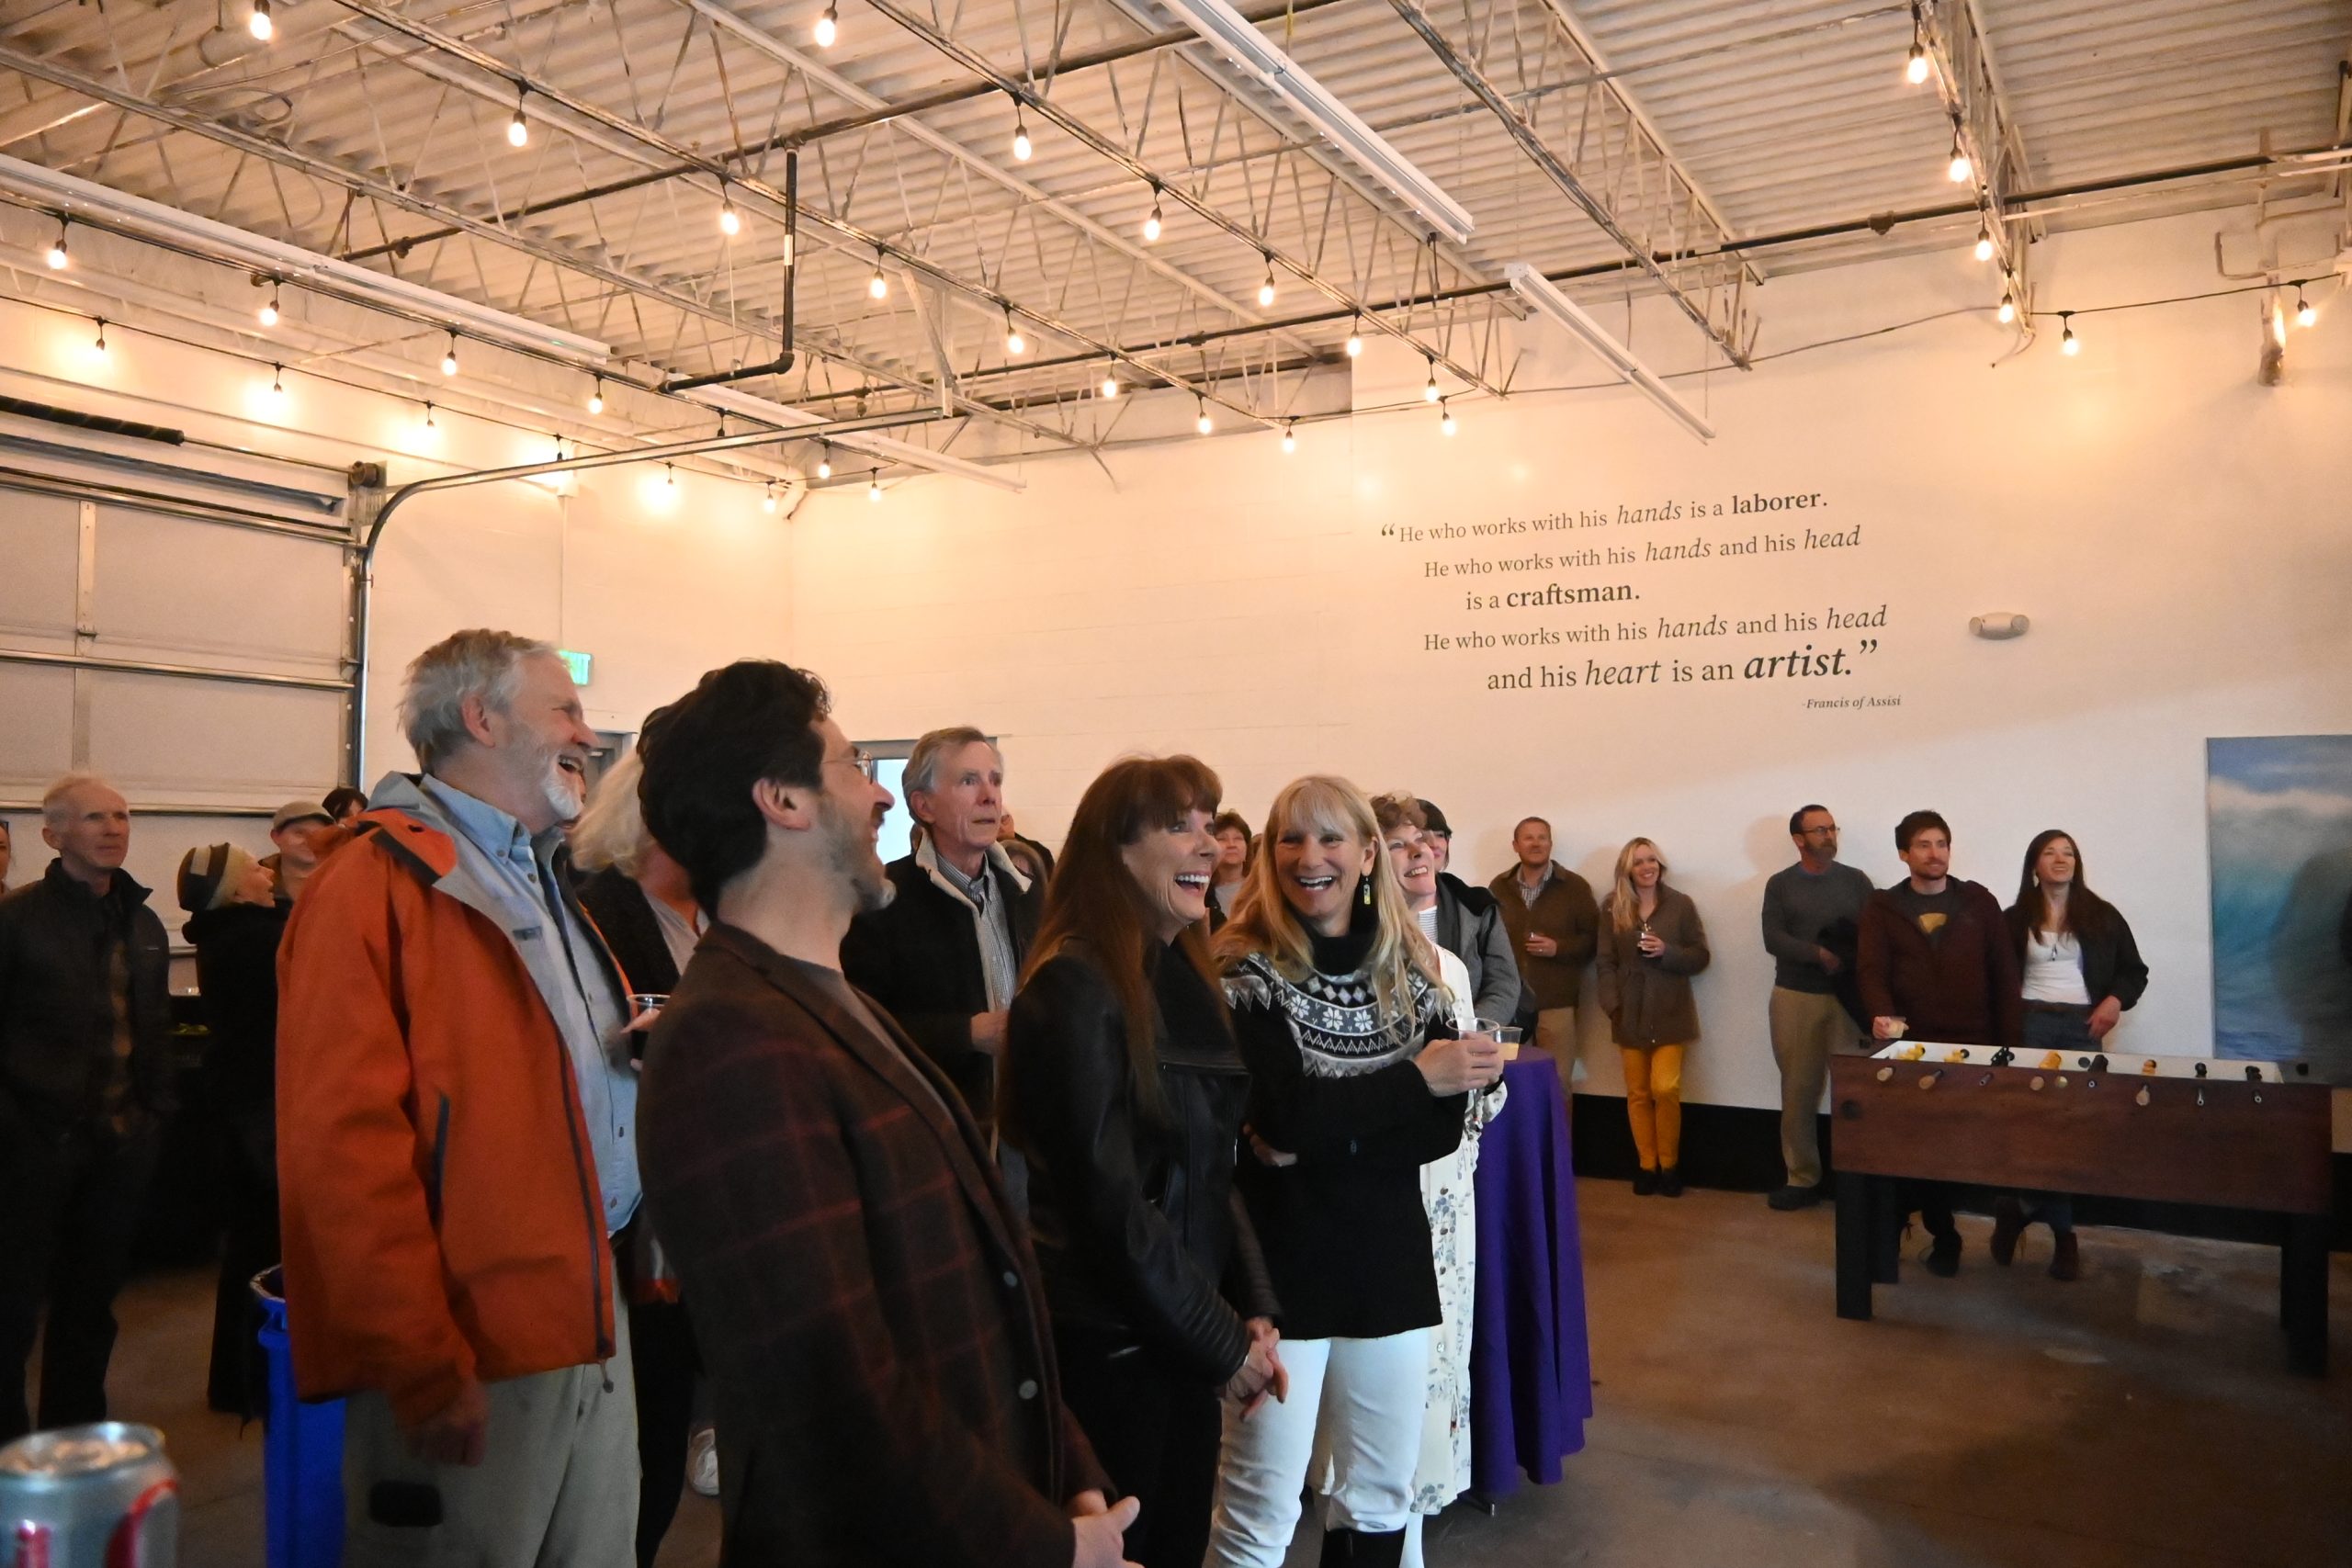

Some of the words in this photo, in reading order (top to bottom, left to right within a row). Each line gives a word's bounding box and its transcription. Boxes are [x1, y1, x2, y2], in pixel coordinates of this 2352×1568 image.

[1429, 523, 1466, 539] who
[1472, 517, 1526, 536] works
[1532, 513, 1573, 531] with
[1580, 510, 1607, 527] his
[1618, 500, 1681, 525] hands
[1690, 502, 1706, 518] is
[1713, 504, 1724, 516] a
[1732, 493, 1827, 514] laborer.
[1425, 562, 1449, 577] He
[1453, 558, 1492, 574] who
[1498, 553, 1553, 571] works
[1559, 548, 1600, 567] with
[1608, 547, 1635, 564] his
[1646, 537, 1712, 561] hands
[1720, 536, 1757, 556] and
[1765, 534, 1795, 552] his
[1804, 525, 1860, 549] head
[1466, 592, 1482, 610] is
[1489, 595, 1499, 608] a
[1507, 583, 1640, 607] craftsman.
[1424, 634, 1450, 650] He
[1455, 631, 1496, 649] who
[1501, 627, 1560, 646] works
[1566, 624, 1610, 643] with
[1617, 622, 1647, 640] his
[1658, 615, 1727, 638] hands
[1736, 614, 1777, 634] and
[1784, 613, 1817, 631] his
[1826, 604, 1887, 629] head
[1487, 666, 1532, 690] and
[1540, 665, 1577, 687] his
[1586, 660, 1661, 685] heart
[1672, 660, 1692, 682] is
[1702, 664, 1735, 681] an
[1852, 696, 1865, 710] of
[1867, 695, 1901, 707] Assisi
